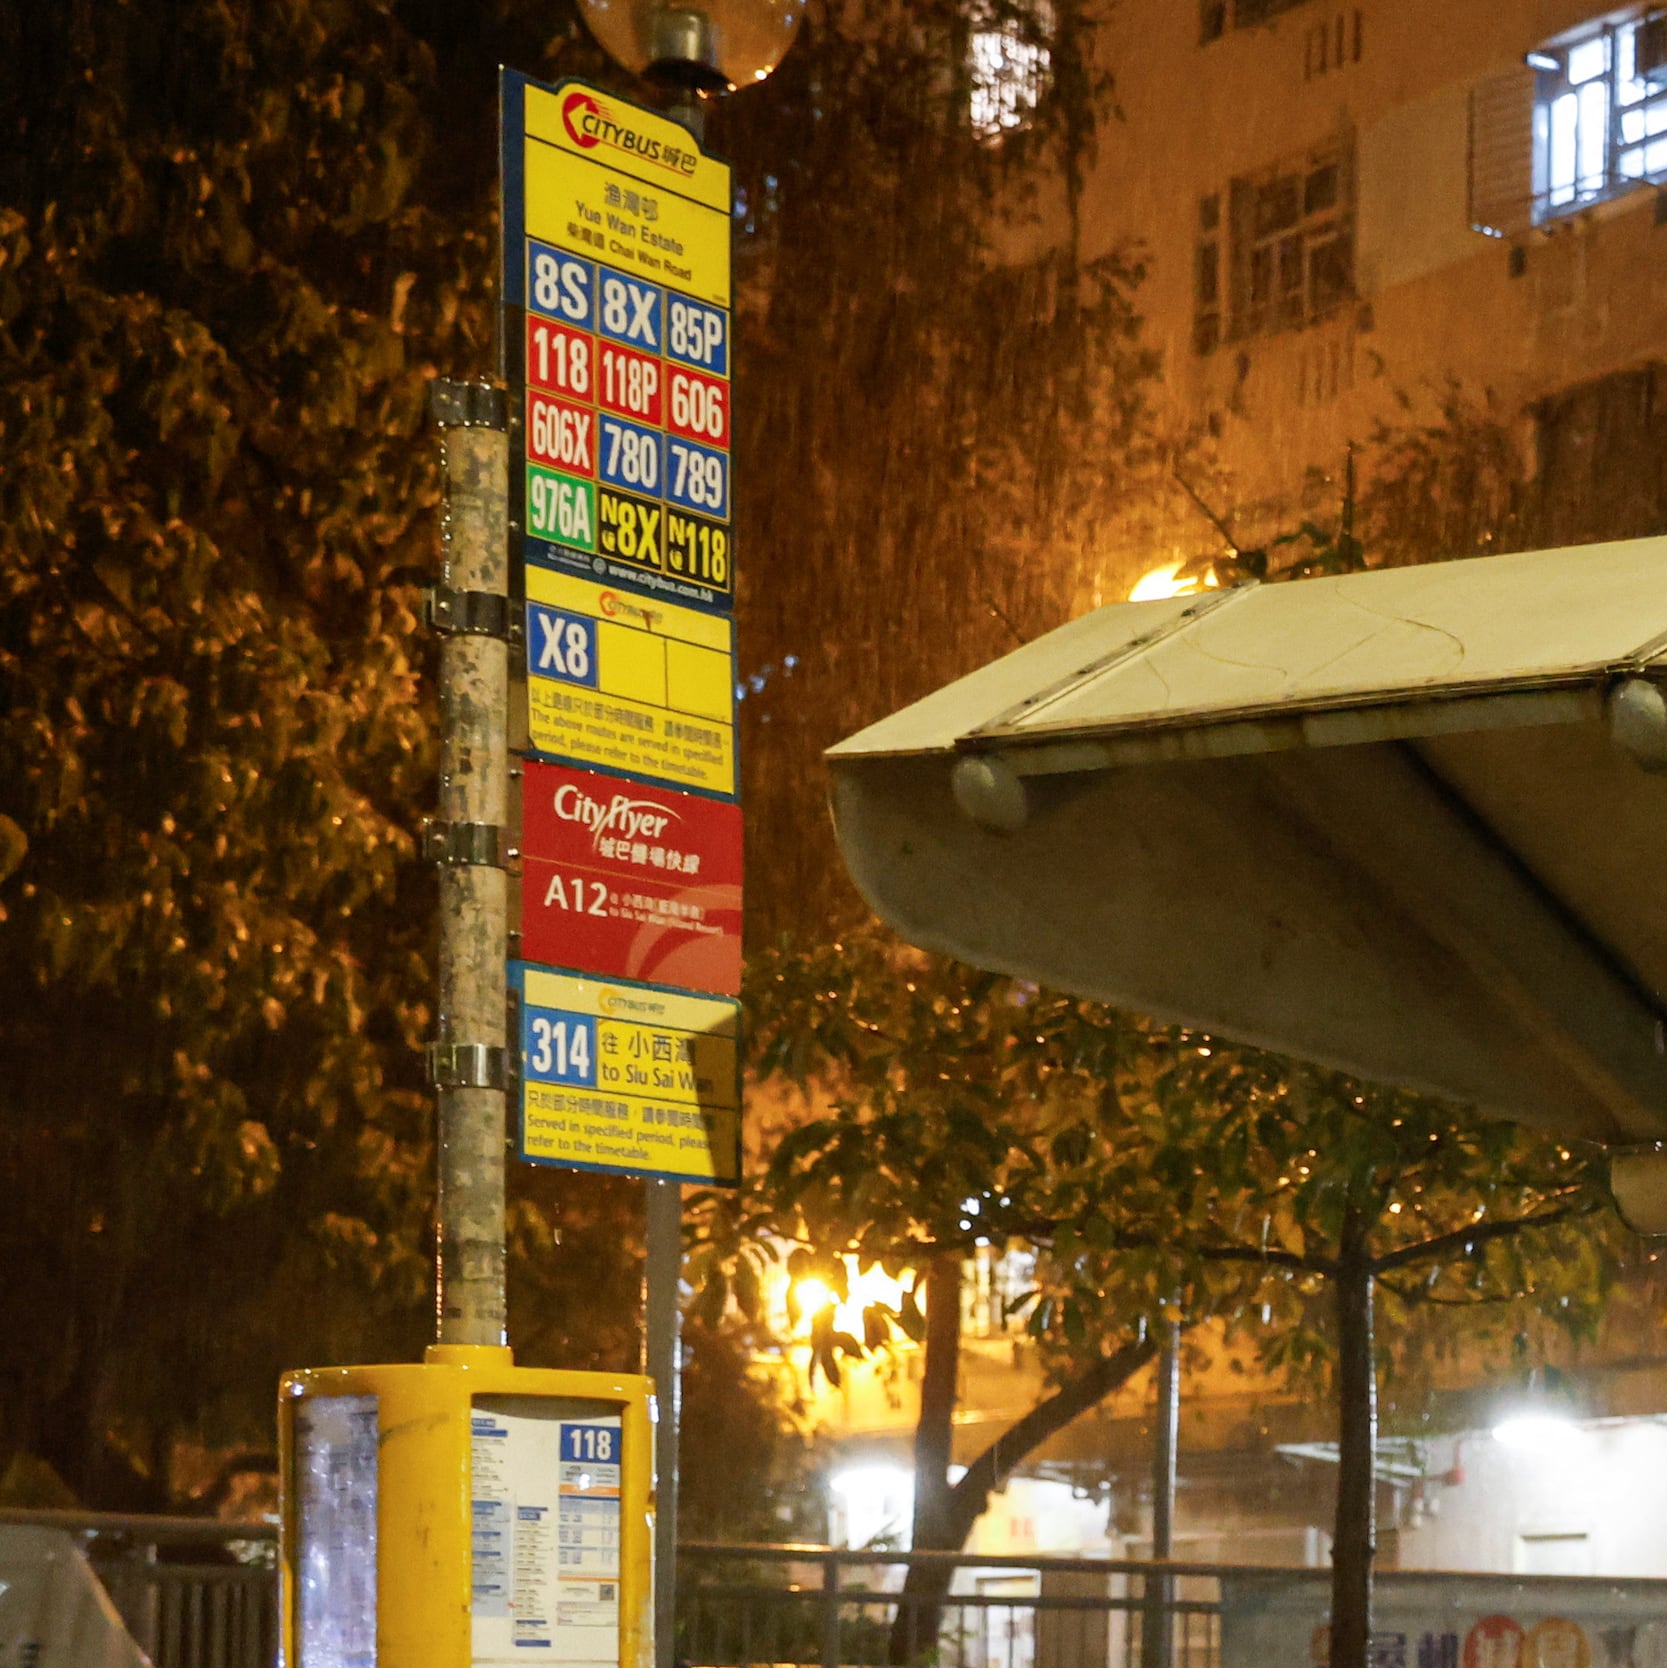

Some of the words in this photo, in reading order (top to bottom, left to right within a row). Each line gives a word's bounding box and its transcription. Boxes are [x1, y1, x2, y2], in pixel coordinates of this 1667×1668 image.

[582, 114, 660, 160] CITYBUS
[576, 200, 601, 224] Yue
[607, 213, 636, 238] Wan
[641, 226, 683, 256] Estate
[535, 253, 588, 320] 8S
[609, 240, 634, 259] Chai
[638, 250, 661, 270] Wan
[664, 260, 692, 281] Road
[603, 278, 657, 346] 8X
[671, 301, 722, 364] 85P
[533, 327, 589, 393] 118
[603, 350, 658, 415] 118P
[533, 400, 590, 470] 606X
[672, 374, 723, 438] 606
[604, 423, 658, 489] 780
[671, 445, 722, 509] 789
[532, 475, 591, 543] 976A
[601, 494, 661, 565] N8X
[669, 514, 725, 583] N118
[538, 613, 589, 678] X8
[554, 784, 668, 843] Cityflyer
[544, 875, 608, 917] A12
[532, 1018, 590, 1078] 314
[603, 1064, 620, 1081] to
[625, 1064, 648, 1085] Siu
[653, 1068, 674, 1087] Sai
[527, 1135, 554, 1148] refer
[558, 1136, 570, 1149] to
[574, 1139, 592, 1153] the
[528, 1115, 566, 1131] Served
[569, 1120, 579, 1132] in
[584, 1121, 633, 1141] specified
[570, 1429, 611, 1460] 118
